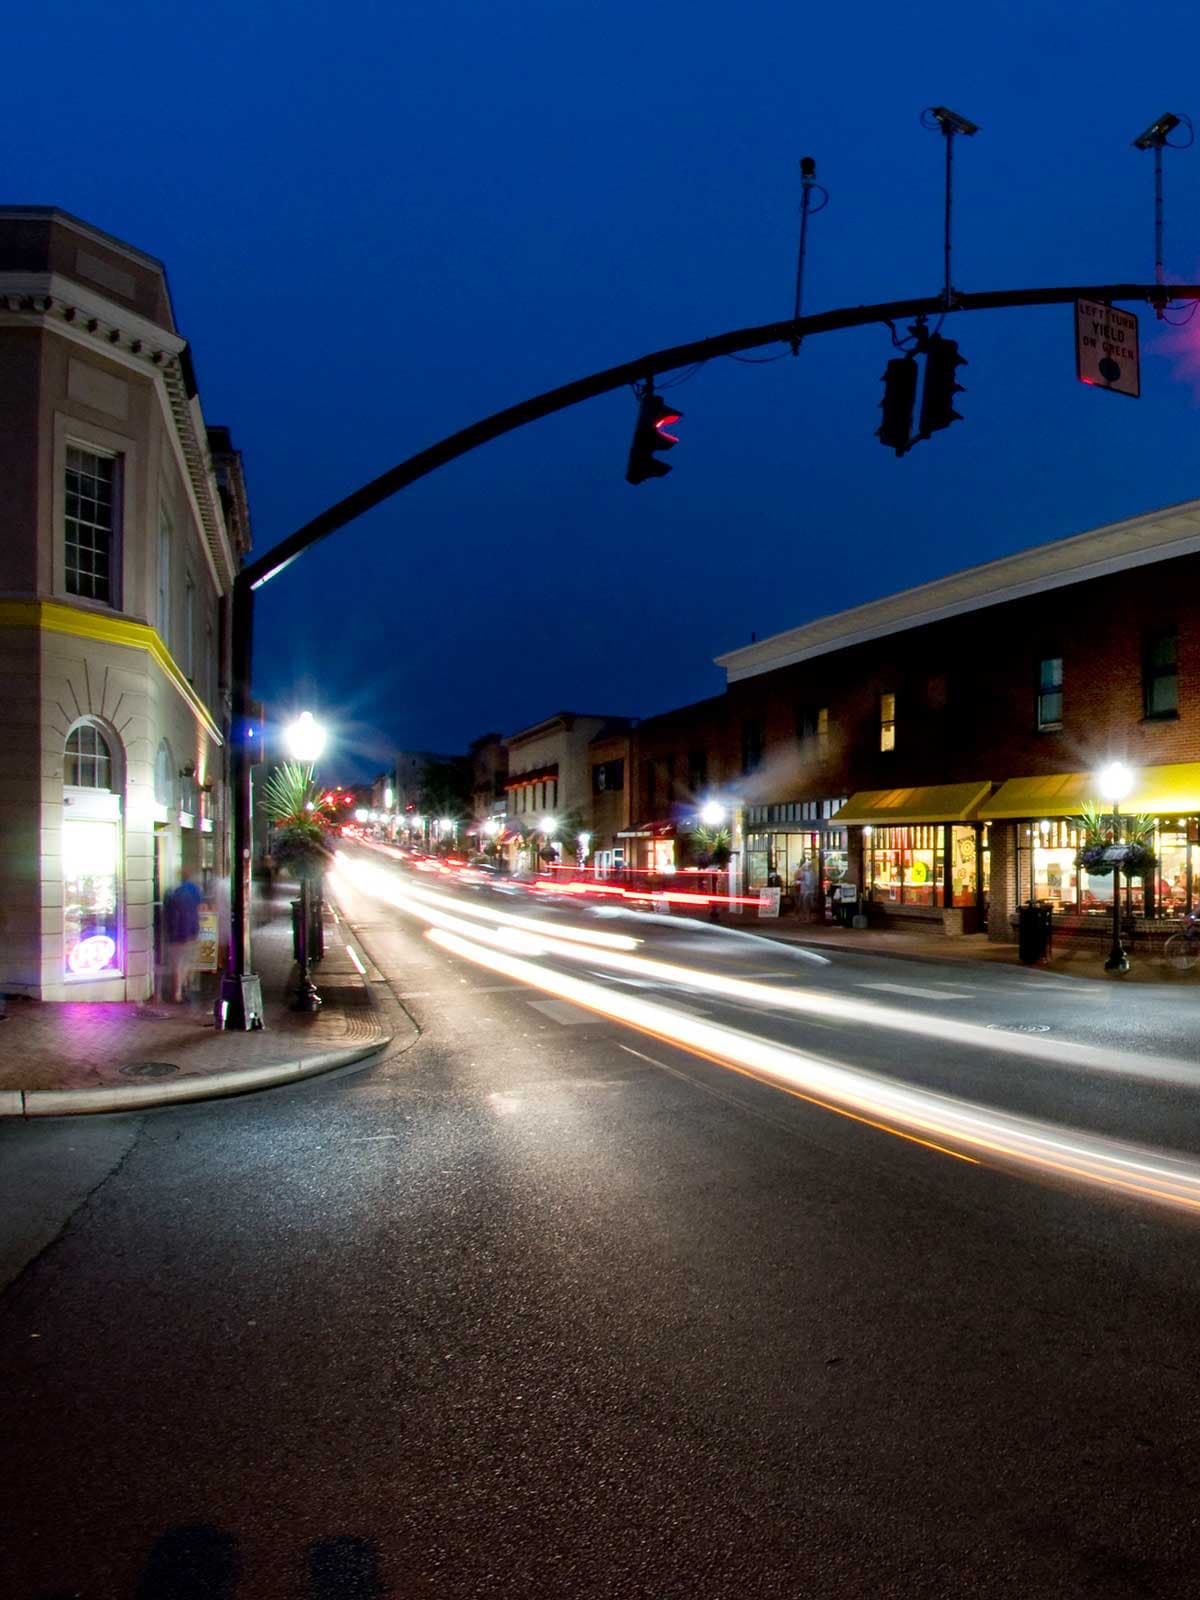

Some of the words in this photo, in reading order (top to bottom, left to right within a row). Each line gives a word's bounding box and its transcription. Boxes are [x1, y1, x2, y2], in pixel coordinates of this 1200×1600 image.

[1079, 304, 1103, 318] LEFT
[1111, 313, 1134, 329] TURN
[1093, 321, 1125, 343] YIELD
[1083, 335, 1096, 348] ON
[1102, 342, 1134, 360] GREEN
